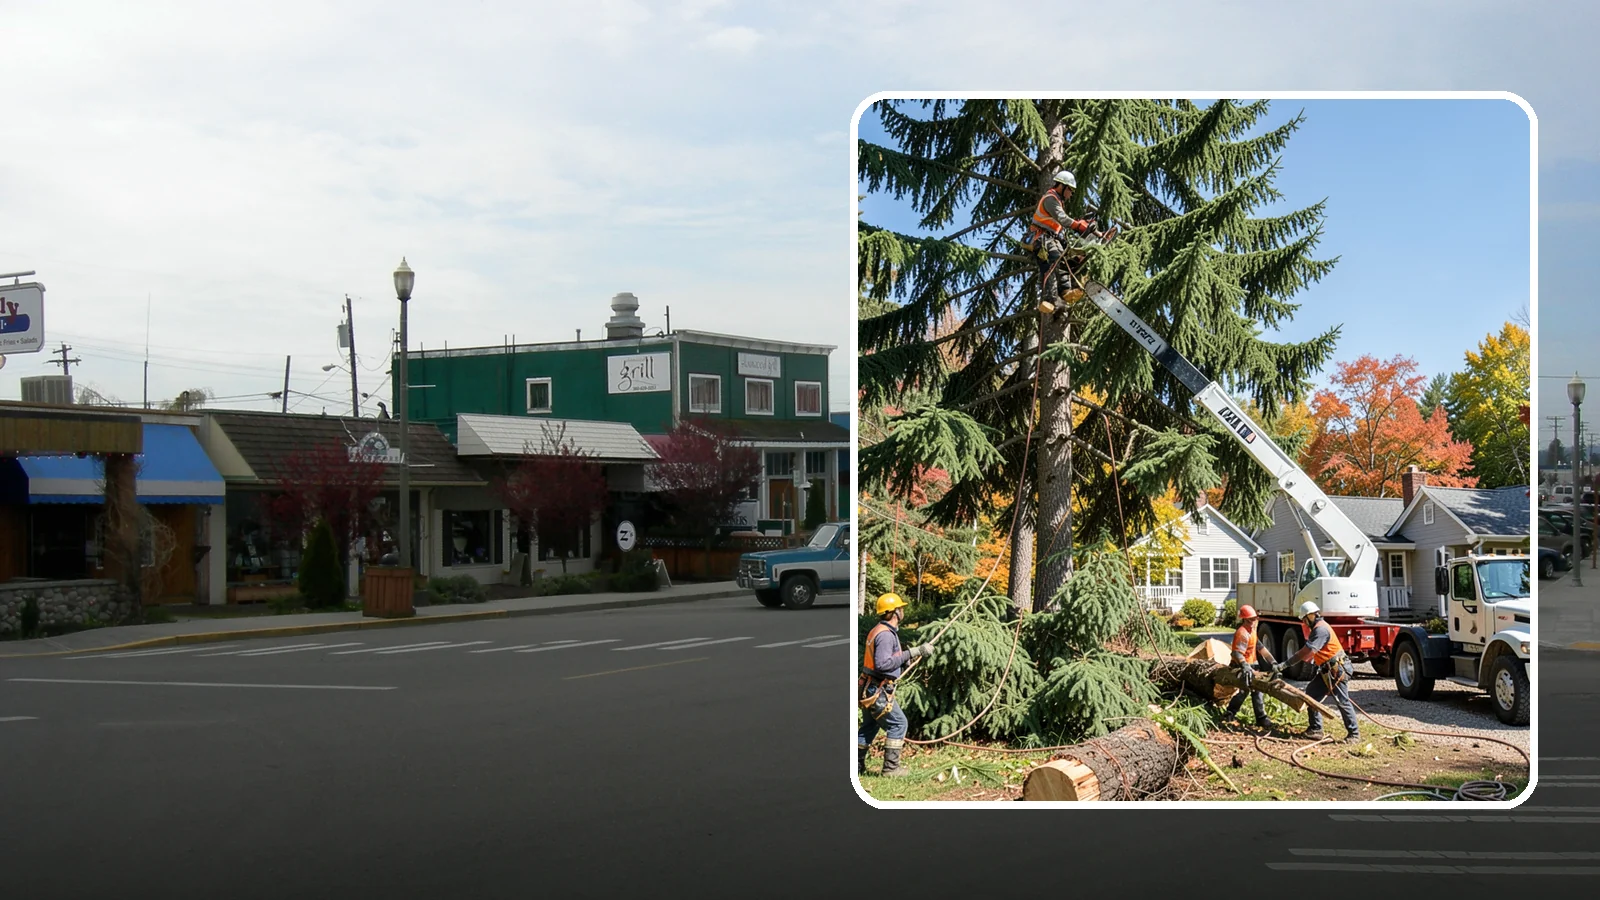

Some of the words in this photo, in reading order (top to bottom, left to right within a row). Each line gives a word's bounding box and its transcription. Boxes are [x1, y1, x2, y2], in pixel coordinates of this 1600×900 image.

[3, 338, 16, 346] Fries
[20, 337, 38, 345] Salads
[618, 356, 654, 391] grill
